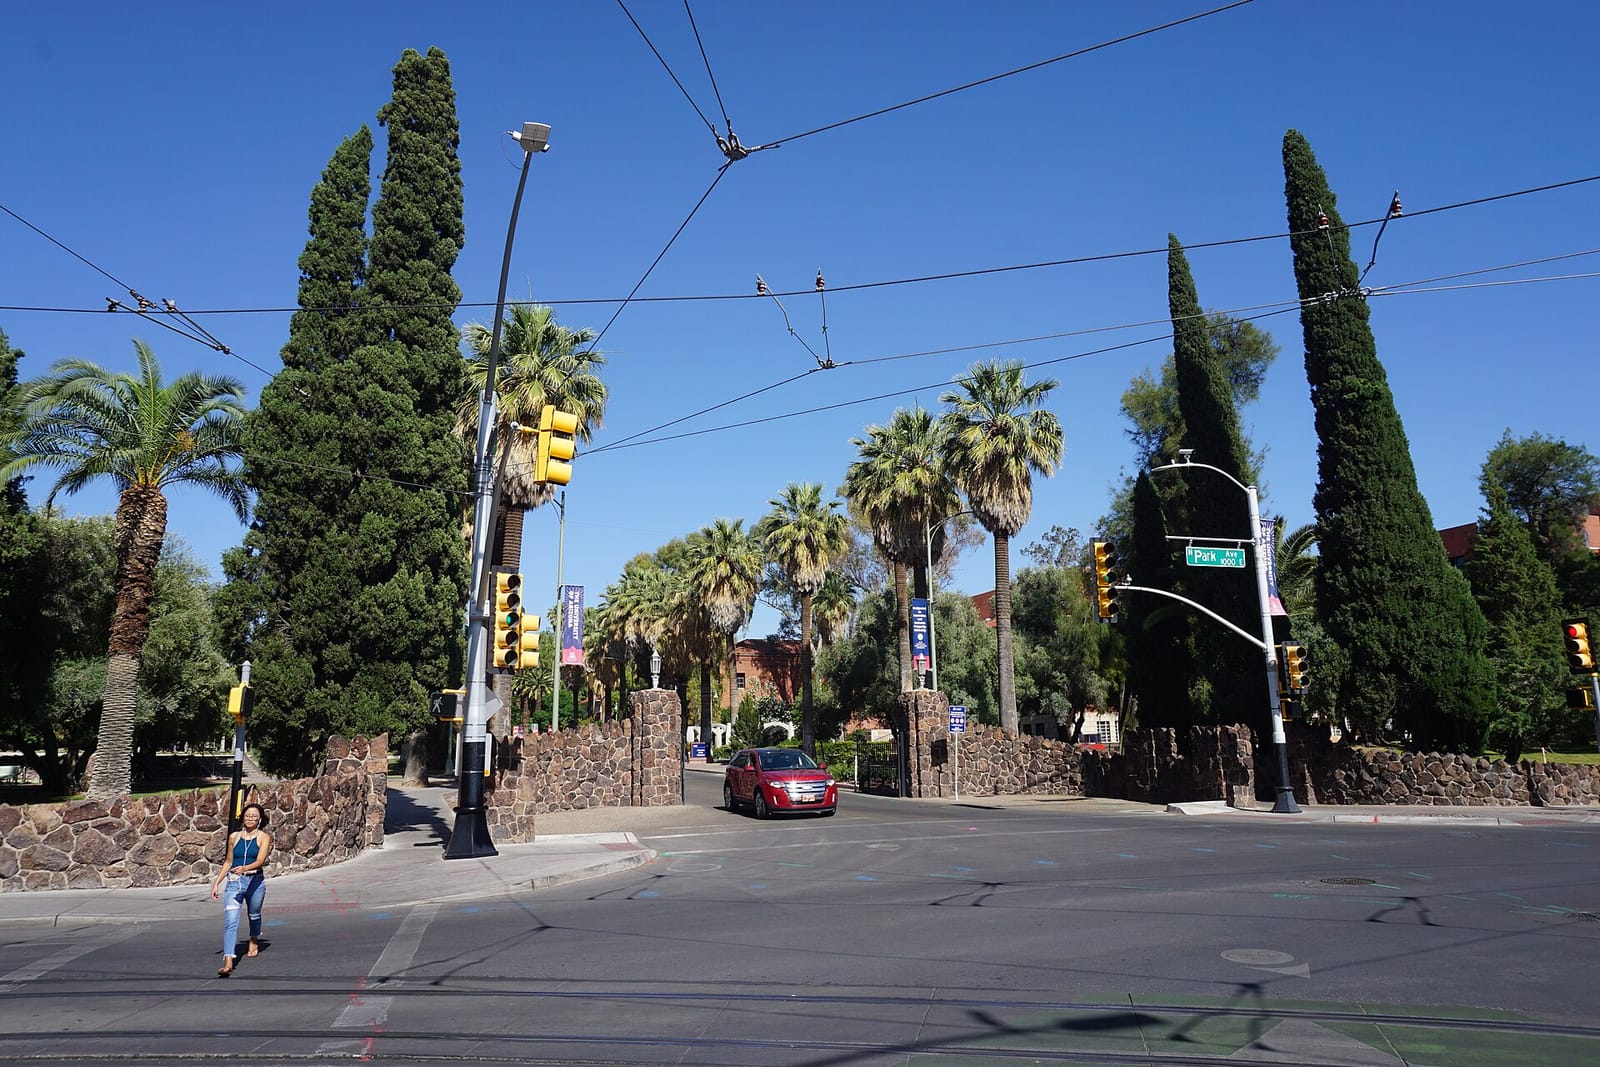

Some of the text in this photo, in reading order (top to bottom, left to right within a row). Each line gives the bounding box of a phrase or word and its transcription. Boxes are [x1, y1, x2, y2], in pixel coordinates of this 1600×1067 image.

[1194, 549, 1238, 563] Park Ave
[1220, 558, 1236, 566] 1000
[1266, 543, 1274, 587] UNIVERSITY
[568, 590, 574, 599] OF
